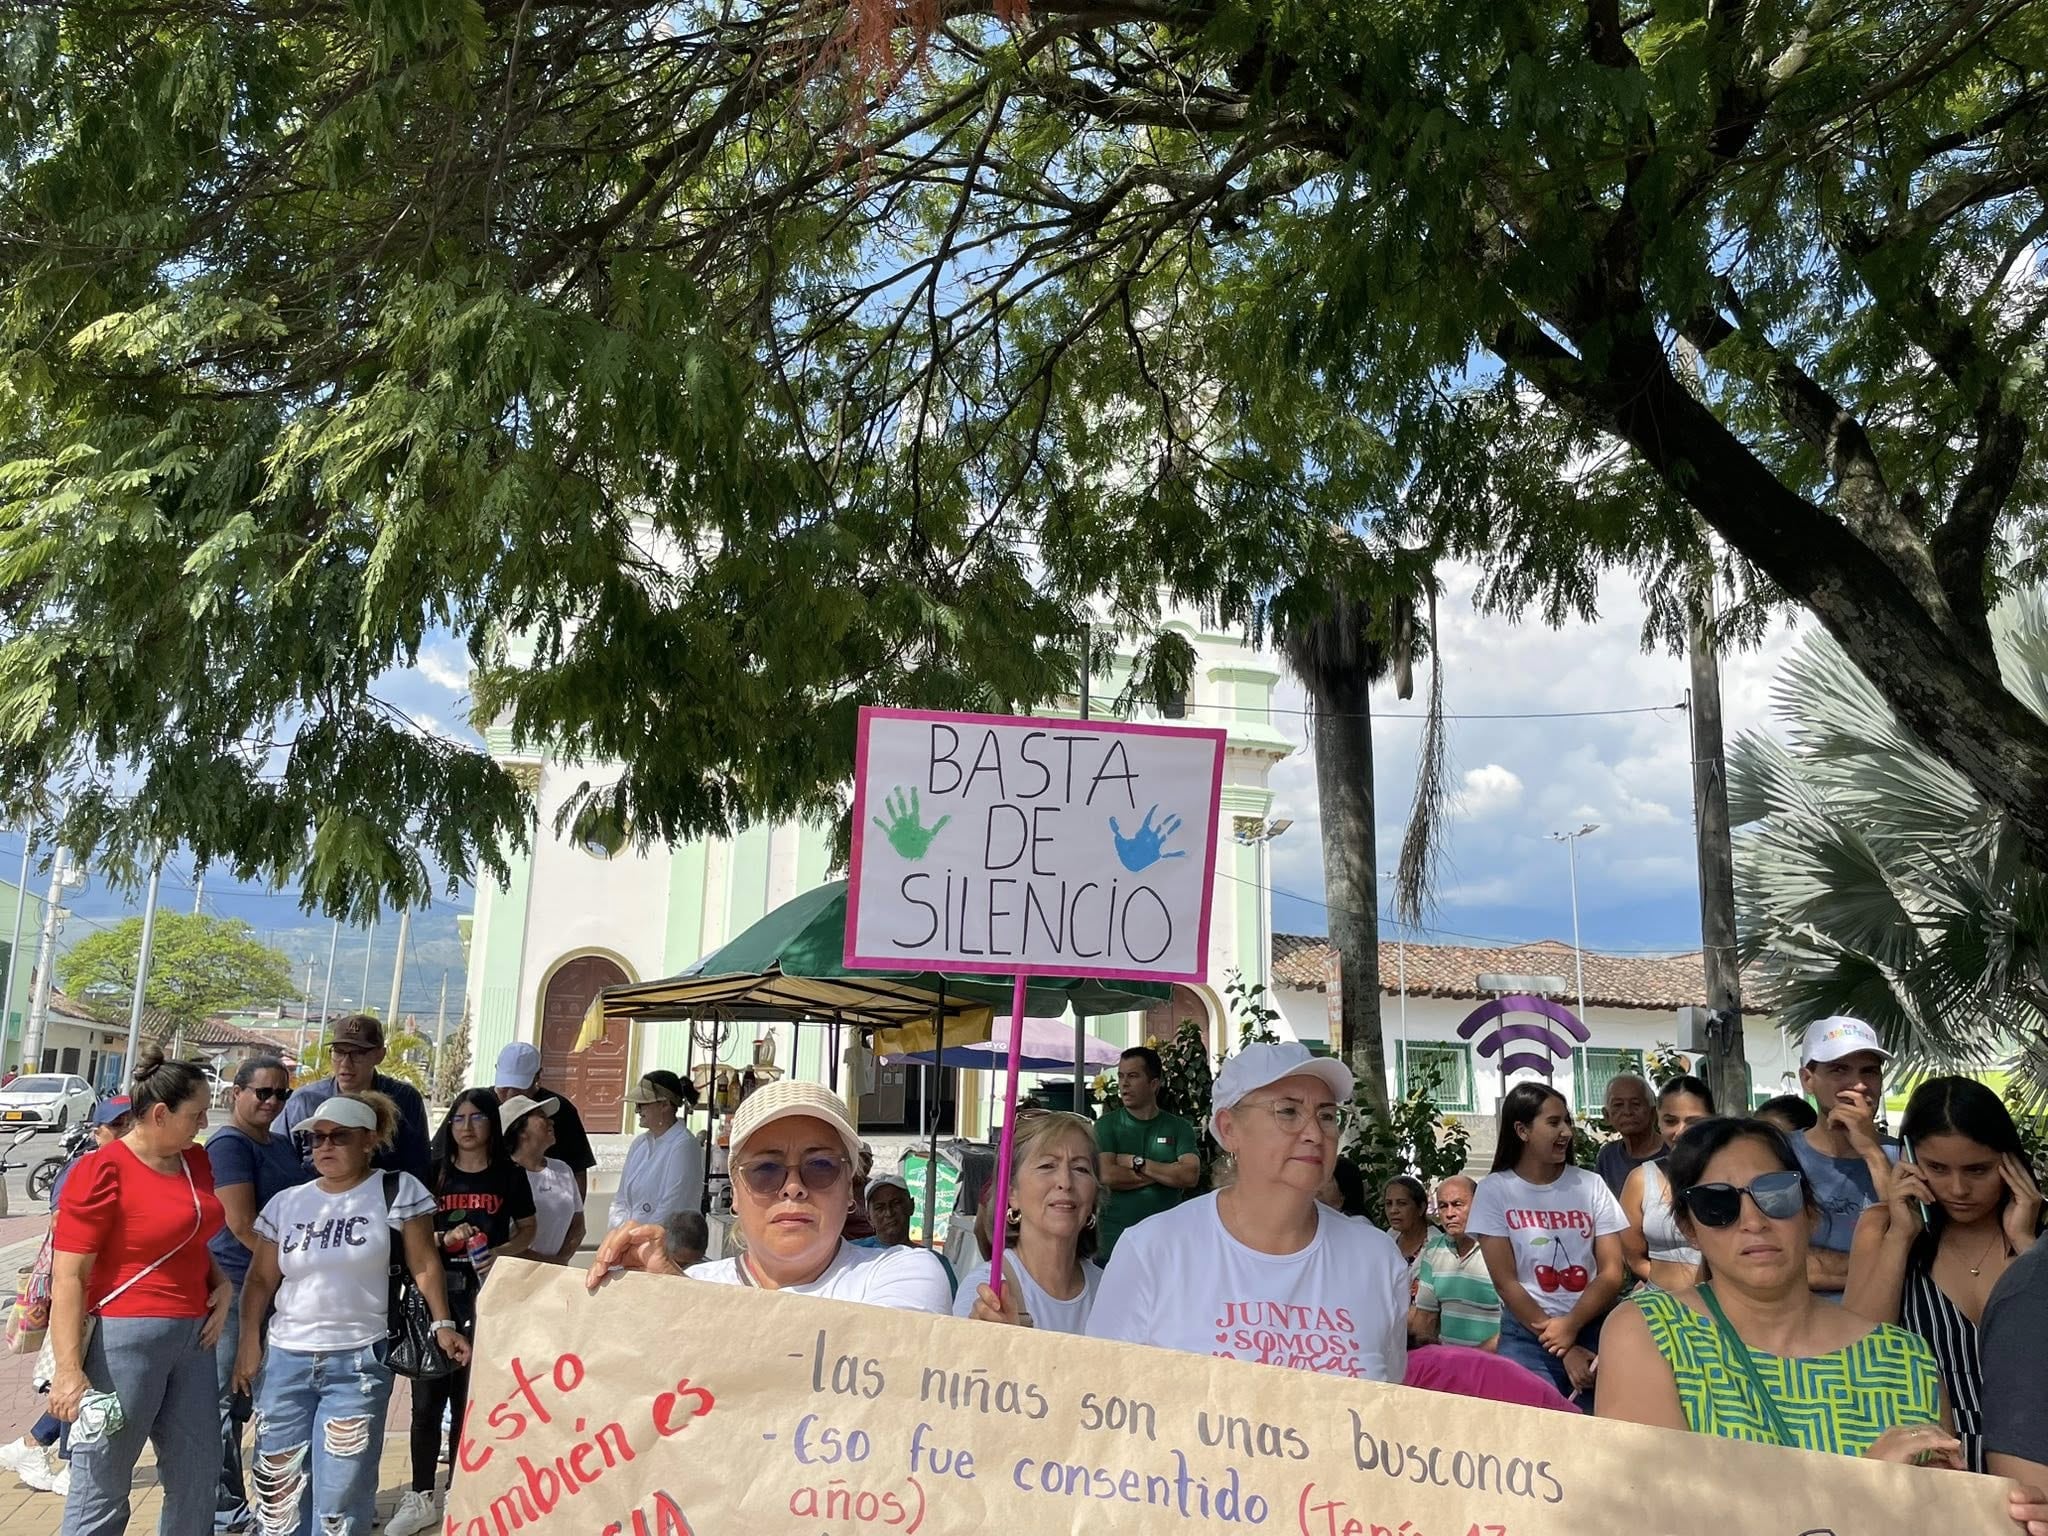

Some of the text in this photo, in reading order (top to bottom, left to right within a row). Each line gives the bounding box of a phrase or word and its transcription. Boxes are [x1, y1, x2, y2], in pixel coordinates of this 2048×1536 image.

[929, 724, 1139, 808] BASTA
[984, 804, 1061, 875] DE
[283, 1216, 369, 1254] CHIC
[1216, 1301, 1355, 1333] JUNTAS
[1234, 1330, 1347, 1355] SOMOS
[459, 1353, 585, 1472] Esto
[652, 1378, 715, 1436] es
[920, 1367, 1048, 1419] niñas
[1080, 1392, 1156, 1441] son
[1198, 1411, 1310, 1460] unas
[1347, 1408, 1563, 1503] busconas
[789, 1476, 926, 1535] años)
[910, 1422, 976, 1479] fue
[1013, 1449, 1268, 1524] consentido
